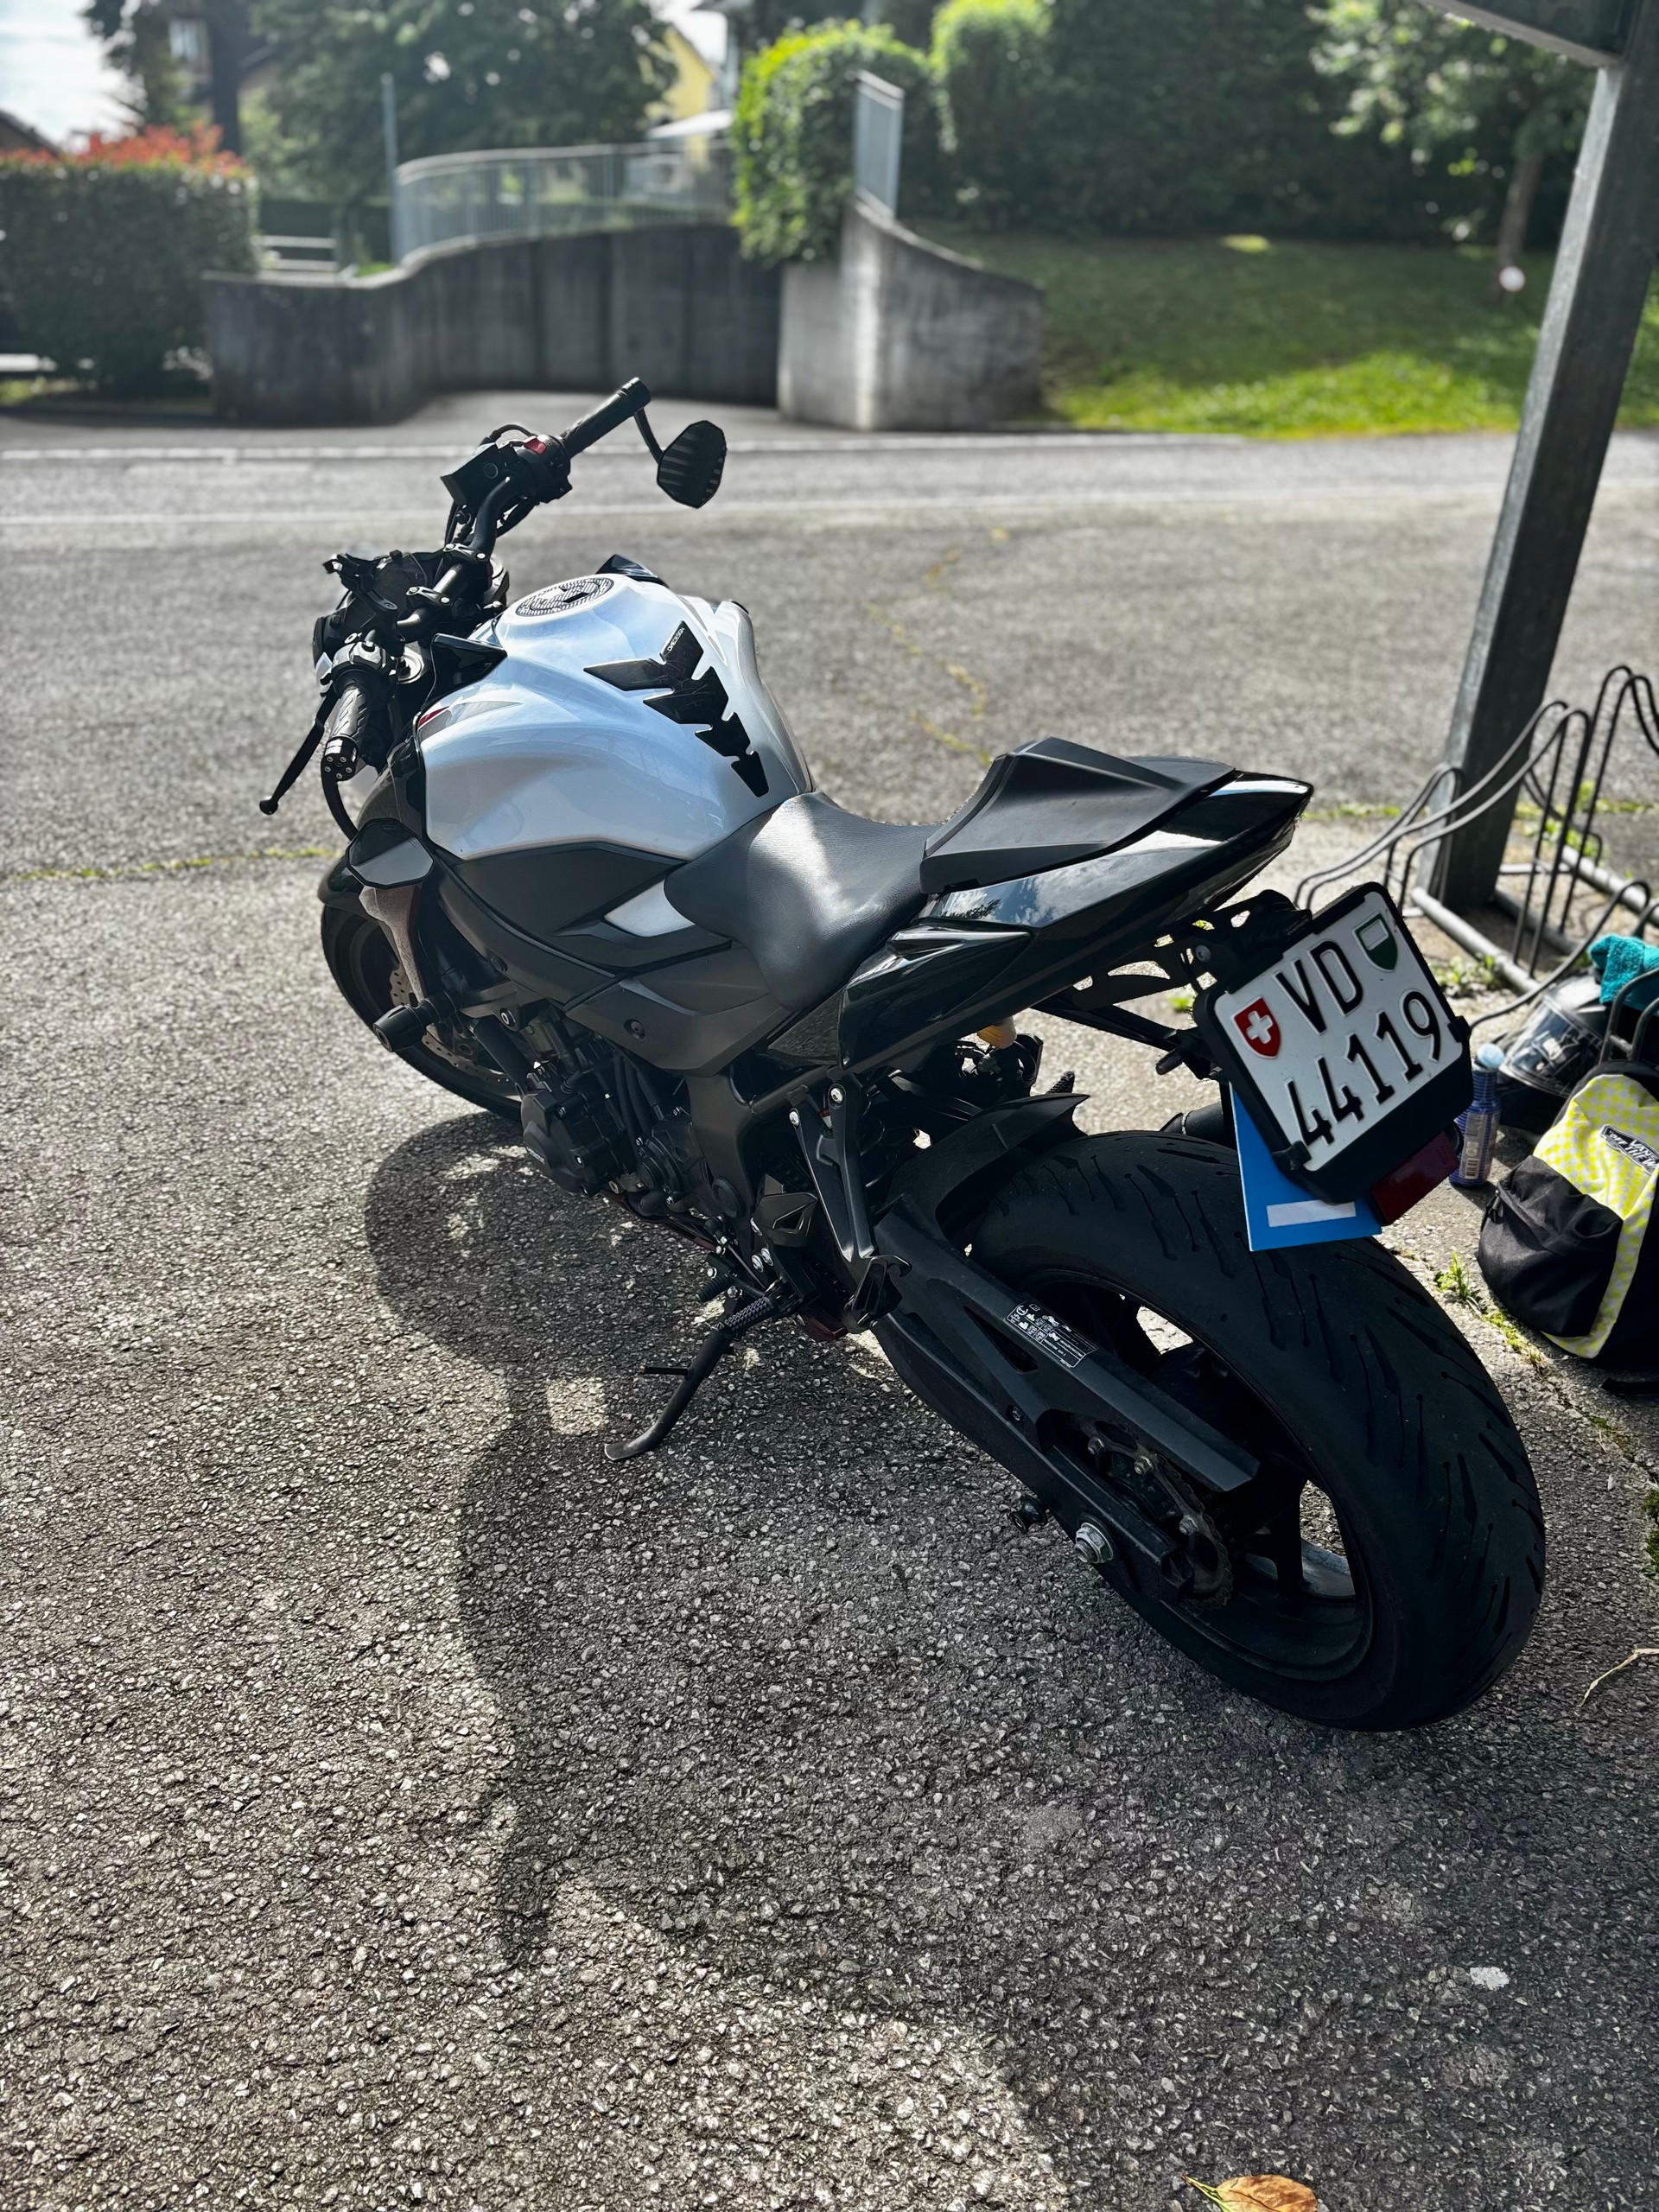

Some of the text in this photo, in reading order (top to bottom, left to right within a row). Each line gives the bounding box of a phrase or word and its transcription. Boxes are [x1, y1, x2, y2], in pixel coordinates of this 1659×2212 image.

[1274, 940, 1363, 1034] VD
[1286, 990, 1441, 1147] 44119
[1624, 1146, 1647, 1160] THE
[1629, 1139, 1657, 1160] VANS
